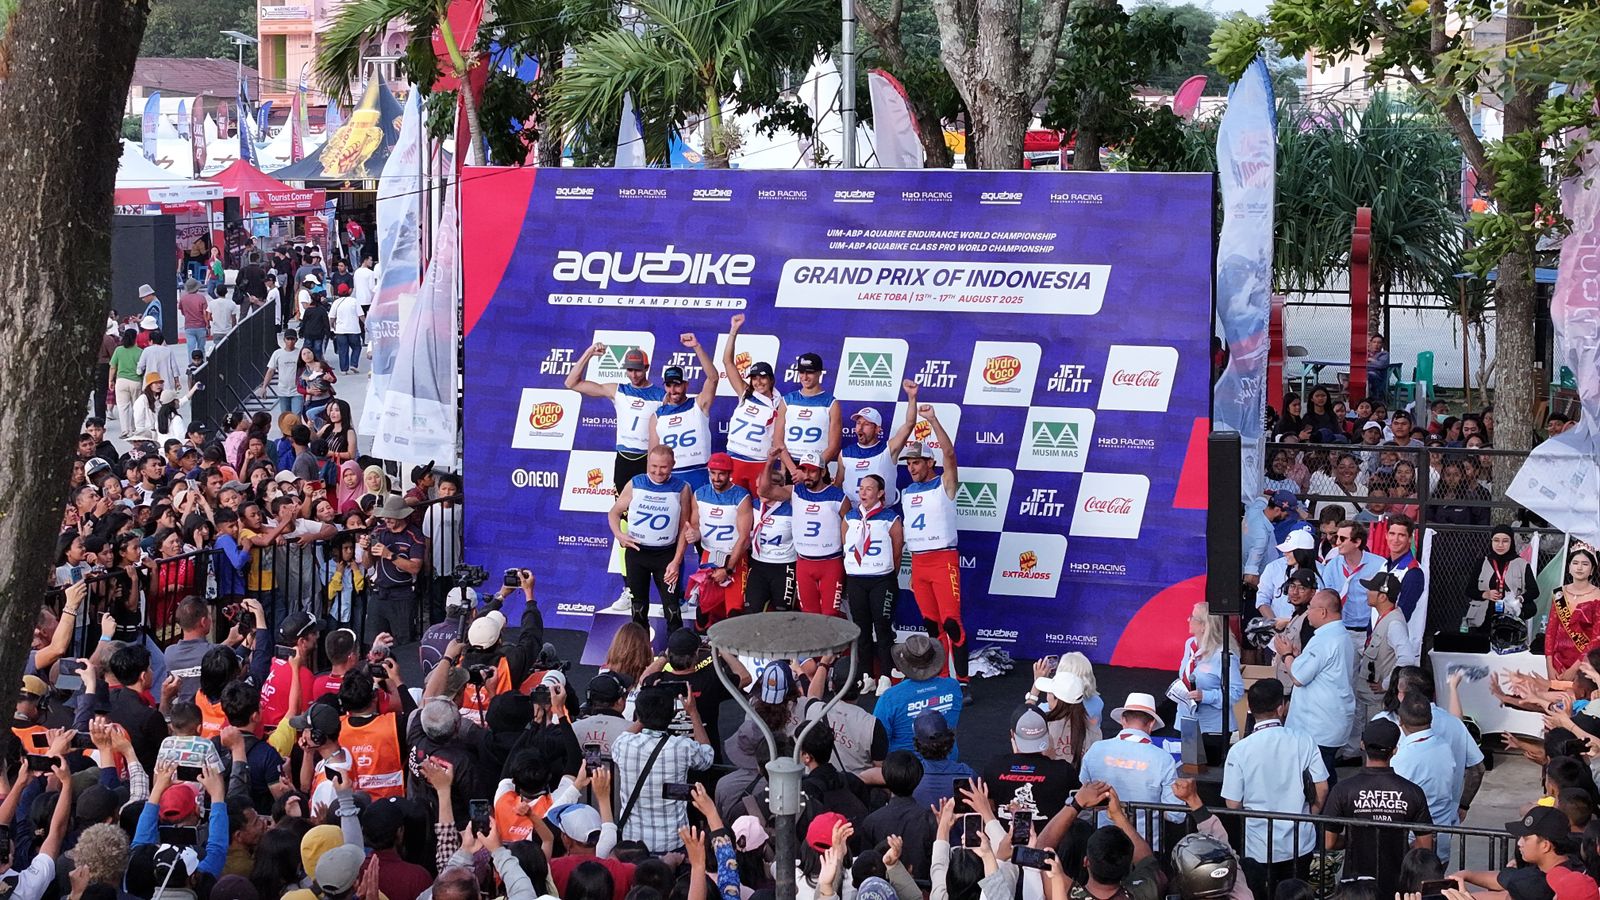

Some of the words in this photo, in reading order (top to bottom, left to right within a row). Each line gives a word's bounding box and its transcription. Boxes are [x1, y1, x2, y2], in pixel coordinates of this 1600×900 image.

[268, 193, 290, 201] Tourist
[827, 229, 863, 238] UIM-ABP
[864, 229, 906, 238] AQUABIKE
[907, 230, 959, 239] ENDURANCE
[960, 231, 990, 239] WORLD
[991, 232, 1057, 241] CHAMPIONSHIP
[829, 241, 865, 250] UIM-ABP
[866, 242, 909, 251] AQUABIKE
[909, 243, 938, 251] CLASS
[938, 243, 956, 252] PRO
[957, 244, 988, 252] WORLD
[988, 245, 1055, 253] CHAMPIONSHIP
[552, 245, 756, 289] aquabike
[794, 266, 873, 285] GRAND
[875, 268, 930, 286] PRIX
[932, 269, 965, 287] OF
[966, 269, 1091, 290] INDONESIA
[553, 296, 605, 304] WORLD
[617, 297, 742, 307] CHAMPIONSHIP
[857, 293, 881, 301] LAKE
[883, 293, 907, 301] TOBA
[958, 295, 998, 303] AUGUST
[998, 296, 1024, 304] 2025
[546, 348, 574, 362] JET
[668, 352, 696, 367] JET
[920, 360, 951, 374] JET
[986, 357, 1019, 373] Hydro
[1054, 365, 1085, 378] JET
[914, 374, 957, 388] PILOT
[986, 368, 1015, 383] Coco
[848, 379, 874, 387] MUSIM
[1047, 378, 1092, 392] PILOT
[532, 403, 561, 417] Hydro
[531, 414, 558, 429] Coco
[731, 418, 766, 443] 72
[788, 426, 823, 443] 99
[663, 429, 697, 449] 86
[976, 432, 1003, 444] UIM
[1120, 438, 1154, 446] RACING
[1032, 449, 1059, 457] MUSIM
[1060, 450, 1079, 458] MAS
[529, 471, 558, 488] NEON
[1026, 489, 1057, 503] JET
[638, 503, 670, 512] MARIANI
[1019, 502, 1064, 517] PILOT
[633, 511, 671, 530] 70
[911, 513, 926, 531] 4
[704, 523, 735, 541] 72
[804, 521, 822, 537] 3
[577, 536, 608, 544] RACING
[959, 556, 976, 568] IM
[1092, 563, 1126, 572] RACING
[1002, 570, 1051, 580] EXTRAJOSS
[783, 565, 795, 606] JTPLT
[428, 632, 453, 640] CREW
[1066, 634, 1098, 643] RACING
[1359, 790, 1403, 800] SAFETY
[1353, 799, 1409, 811] MANAGER
